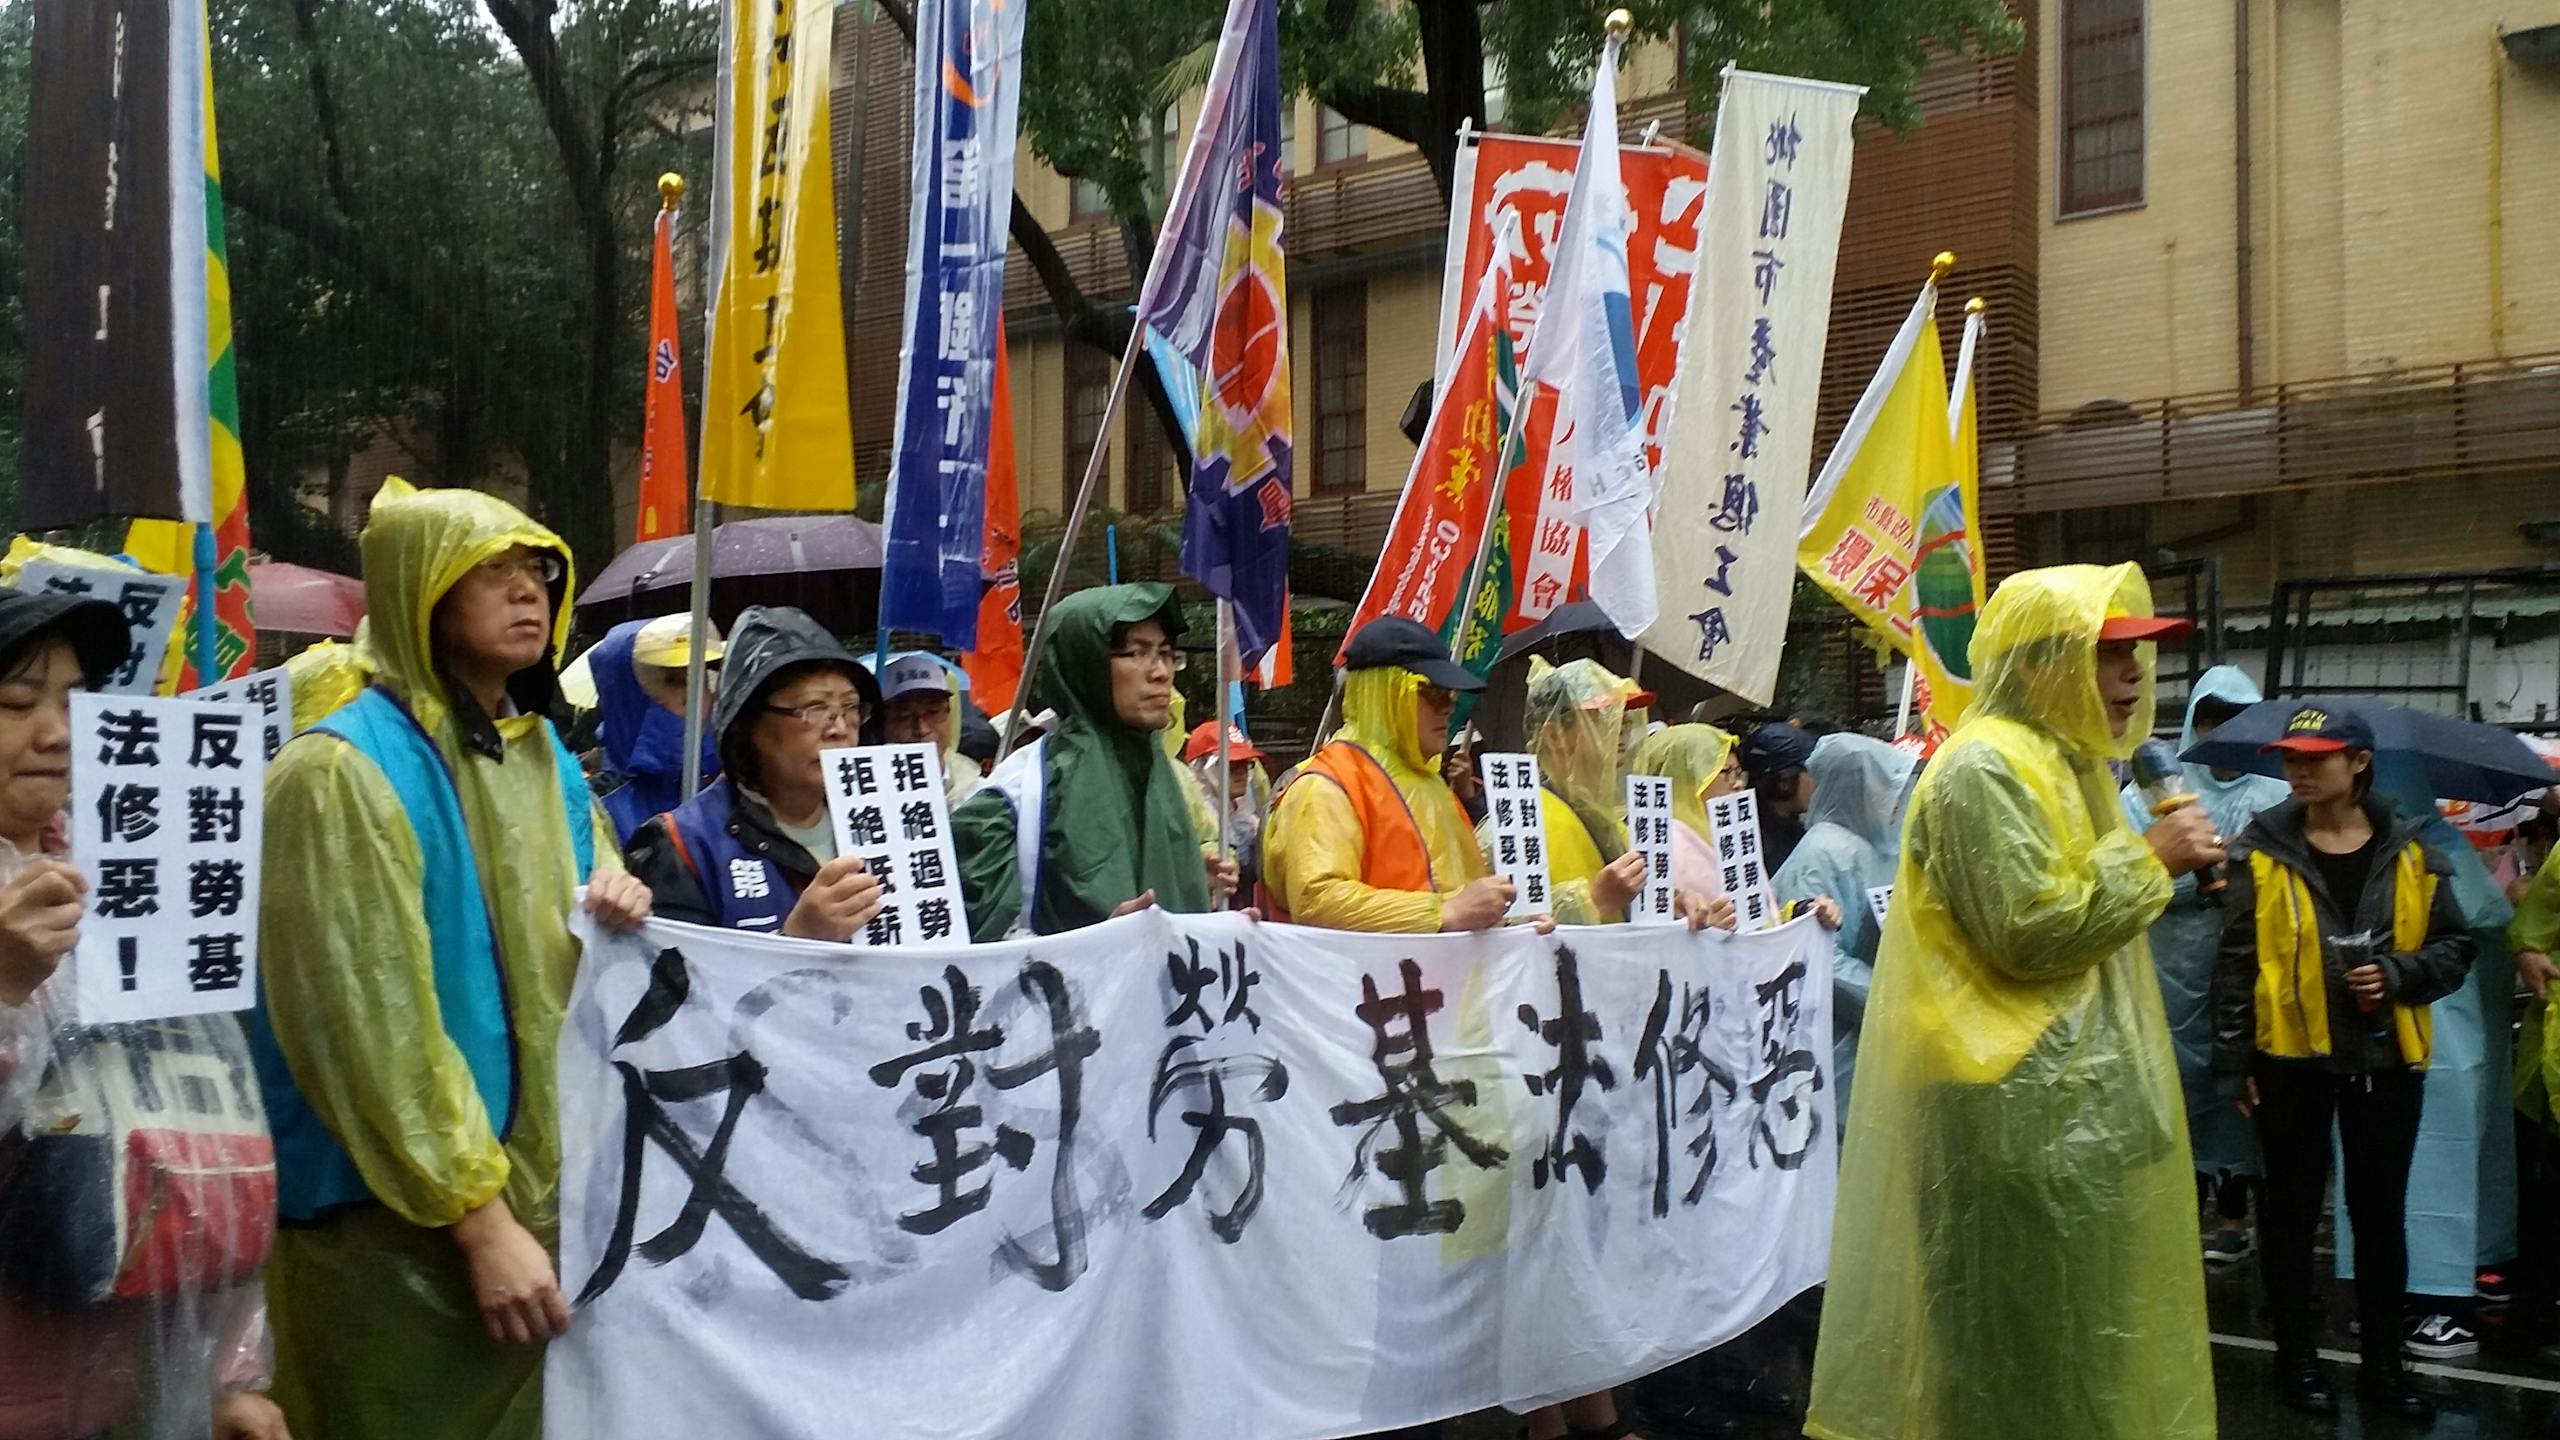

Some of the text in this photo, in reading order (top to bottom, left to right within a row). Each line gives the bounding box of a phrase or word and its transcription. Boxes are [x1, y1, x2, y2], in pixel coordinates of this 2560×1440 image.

[95, 708, 160, 992] 法修惡!
[186, 712, 245, 992] 反對勞基
[891, 752, 953, 941] 拒絕過勞
[1516, 760, 1544, 904] 反對勞基
[1714, 801, 1740, 903] 法修惡
[568, 934, 1827, 1310] 反對勞基法修惡
